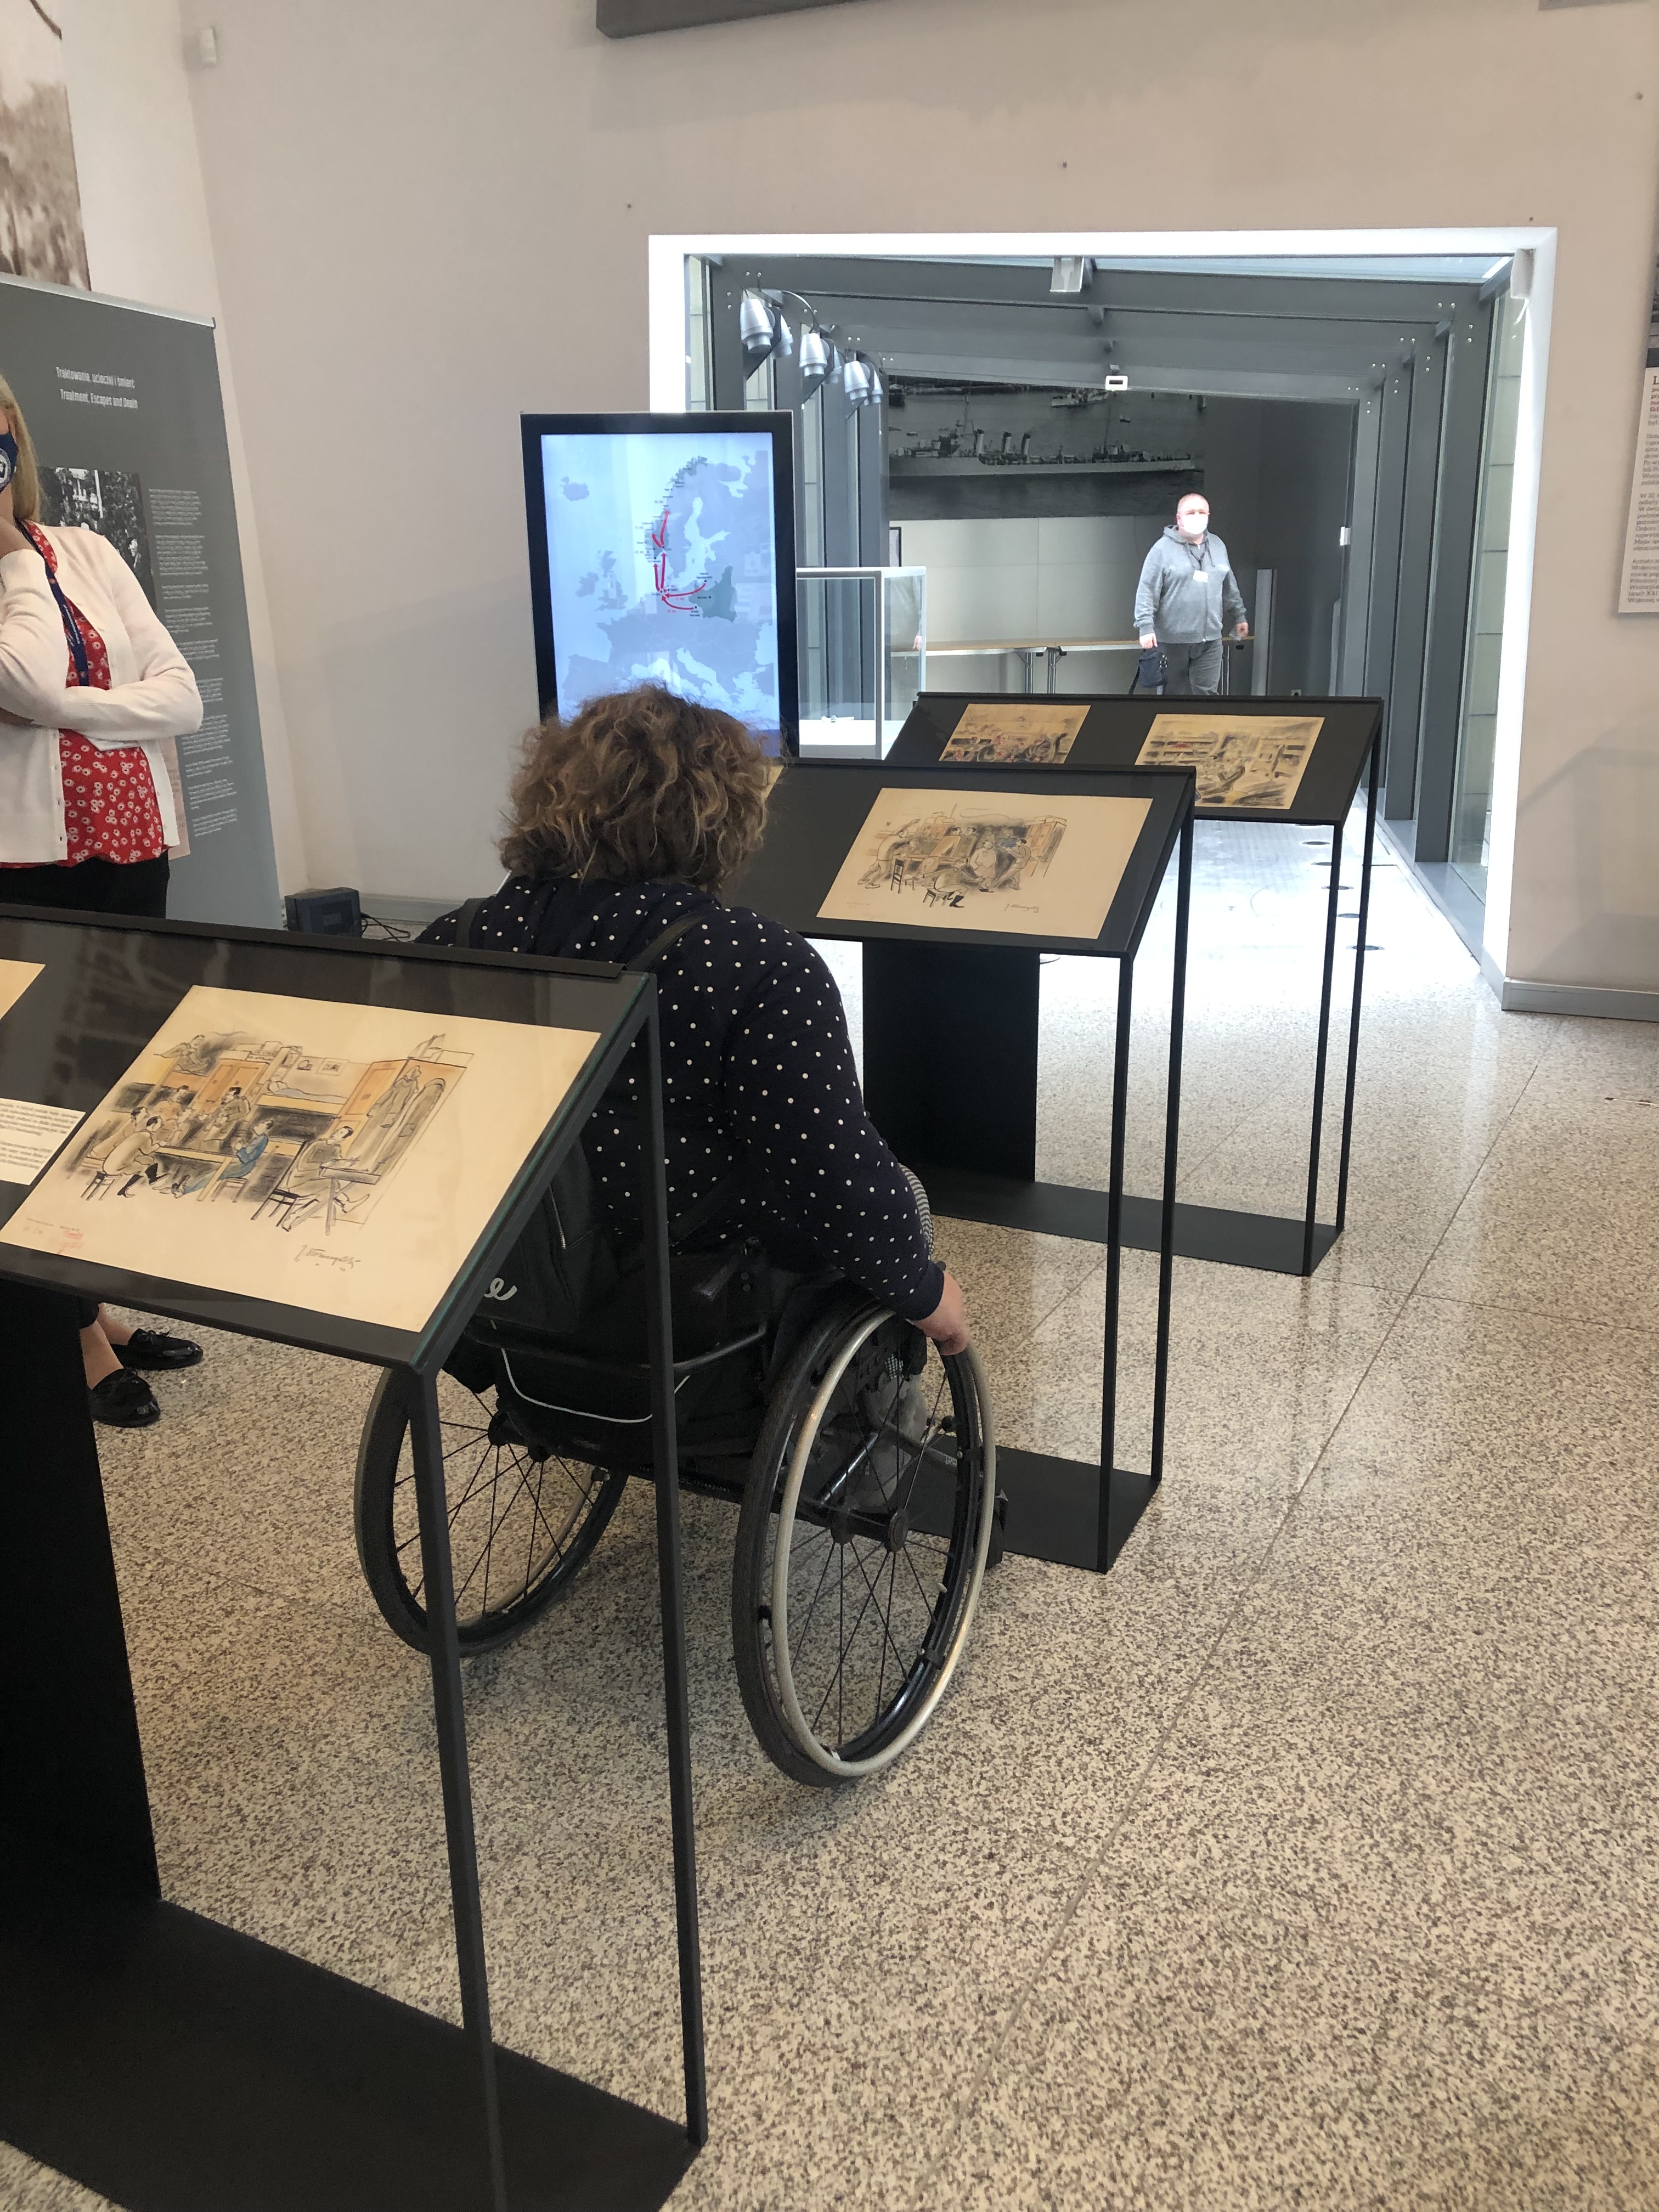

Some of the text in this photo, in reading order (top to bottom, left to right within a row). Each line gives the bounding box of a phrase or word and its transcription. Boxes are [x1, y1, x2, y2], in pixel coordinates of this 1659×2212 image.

[91, 393, 112, 407] Escapes
[112, 397, 122, 407] and
[123, 397, 138, 409] Death
